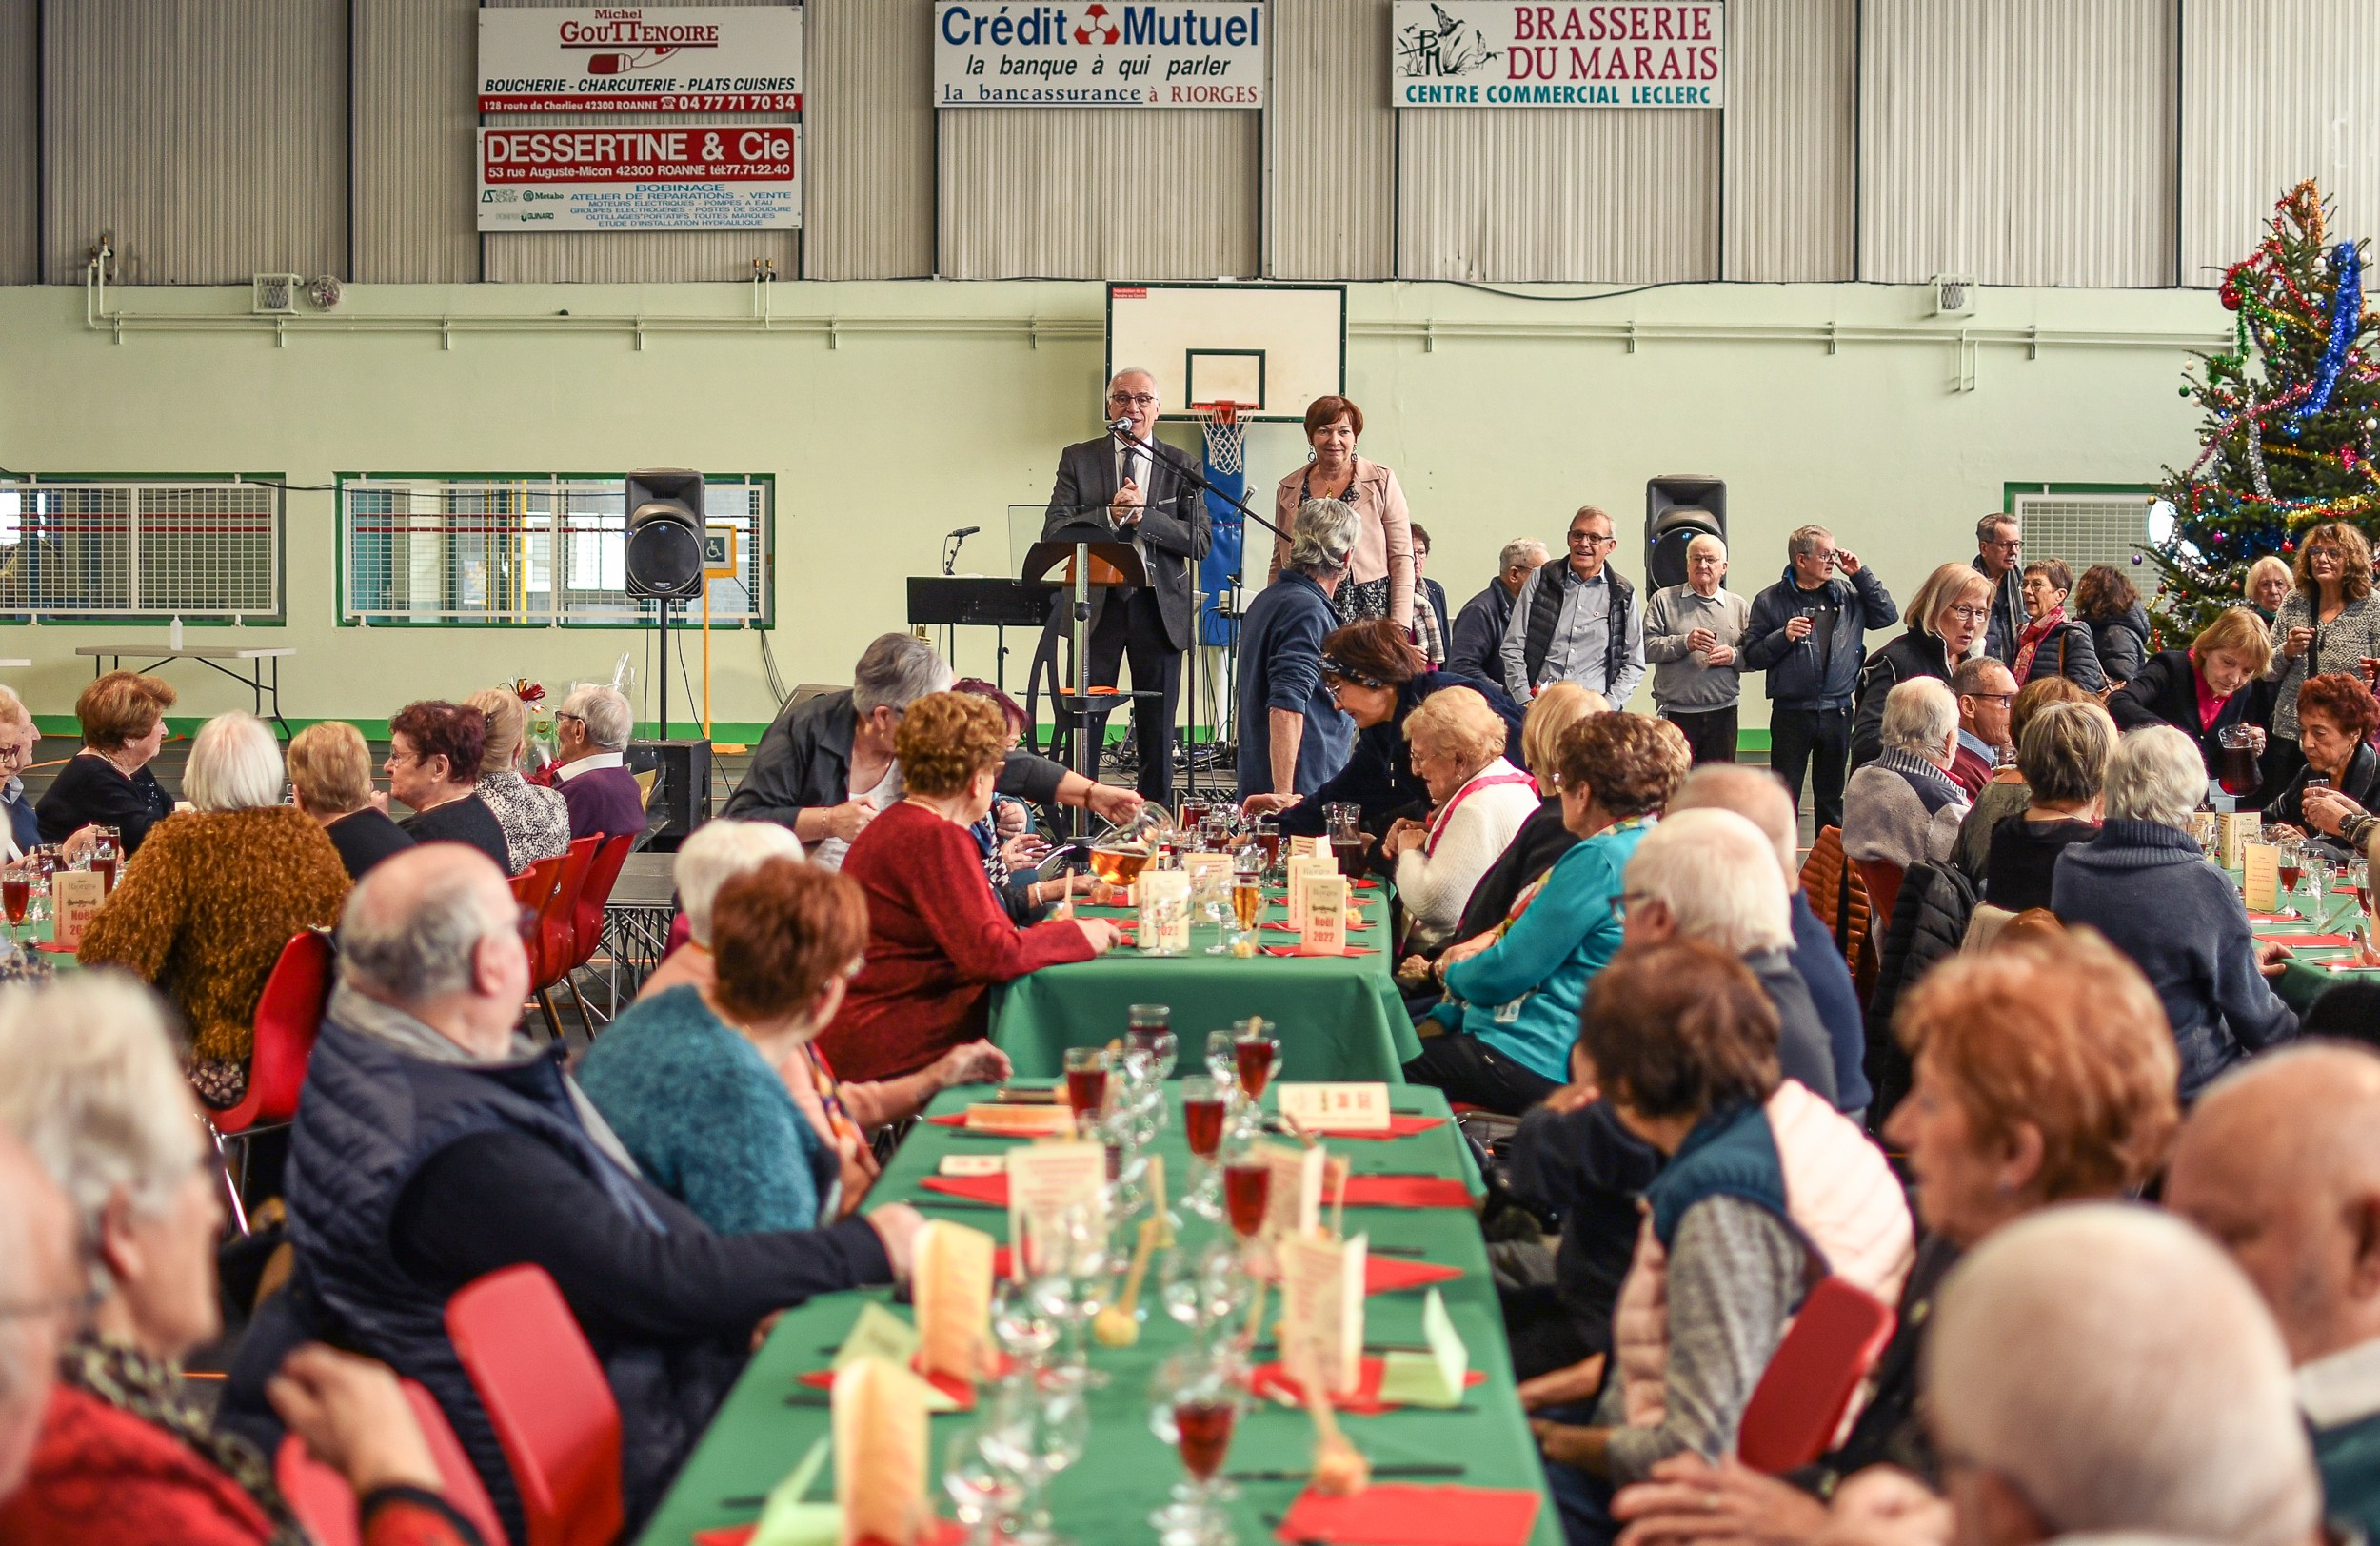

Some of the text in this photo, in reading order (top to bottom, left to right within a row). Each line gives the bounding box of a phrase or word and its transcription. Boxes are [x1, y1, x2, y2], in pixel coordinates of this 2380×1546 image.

[594, 9, 642, 19] Michel
[942, 6, 1259, 46] Crédit Mutuel
[1515, 7, 1712, 40] BRASSERIE
[965, 54, 1231, 81] la banque à qui parler
[1507, 46, 1718, 80] DU MARAIS
[485, 79, 566, 92] BOUCHERIE
[578, 78, 676, 92] CHARCUTERIE
[687, 78, 731, 91] PLATS
[733, 77, 795, 90] CUISNES
[944, 83, 1258, 103] la bancassurance à RIORGES
[484, 95, 796, 110] 128 route de Charlieu 42300 ROANNE 04 77 71 70 34
[1406, 84, 1711, 104] CENTRE COMMERCIAL LECLERC
[487, 131, 790, 163] DESSERTINE & Cie
[488, 167, 504, 178] 53
[506, 168, 526, 178] rue
[529, 165, 612, 179] Auguste-Micon
[616, 165, 654, 177] 42300
[658, 165, 705, 176] ROANNE
[636, 184, 725, 192] BOBINAGE
[1315, 916, 1335, 927] Noël
[1313, 930, 1335, 941] 2022
